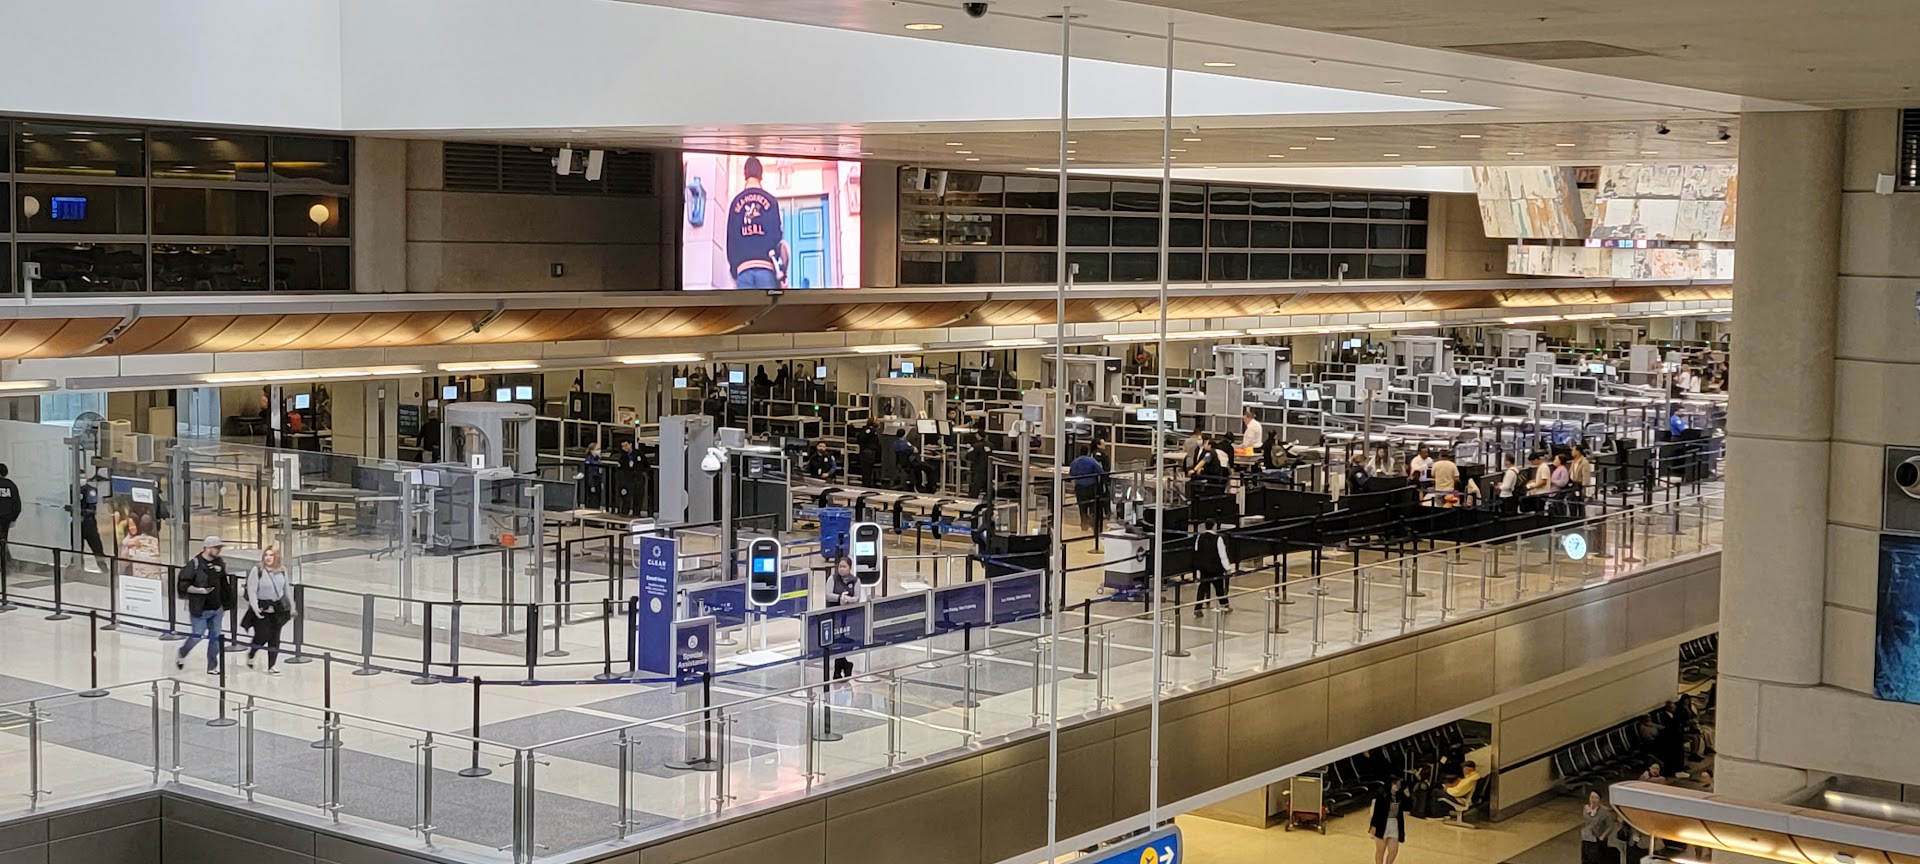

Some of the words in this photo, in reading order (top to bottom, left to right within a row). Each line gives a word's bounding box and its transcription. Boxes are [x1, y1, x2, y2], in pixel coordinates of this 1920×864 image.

[647, 559, 667, 567] CLEAR
[682, 651, 703, 660] Special
[677, 658, 708, 669] Assistance
